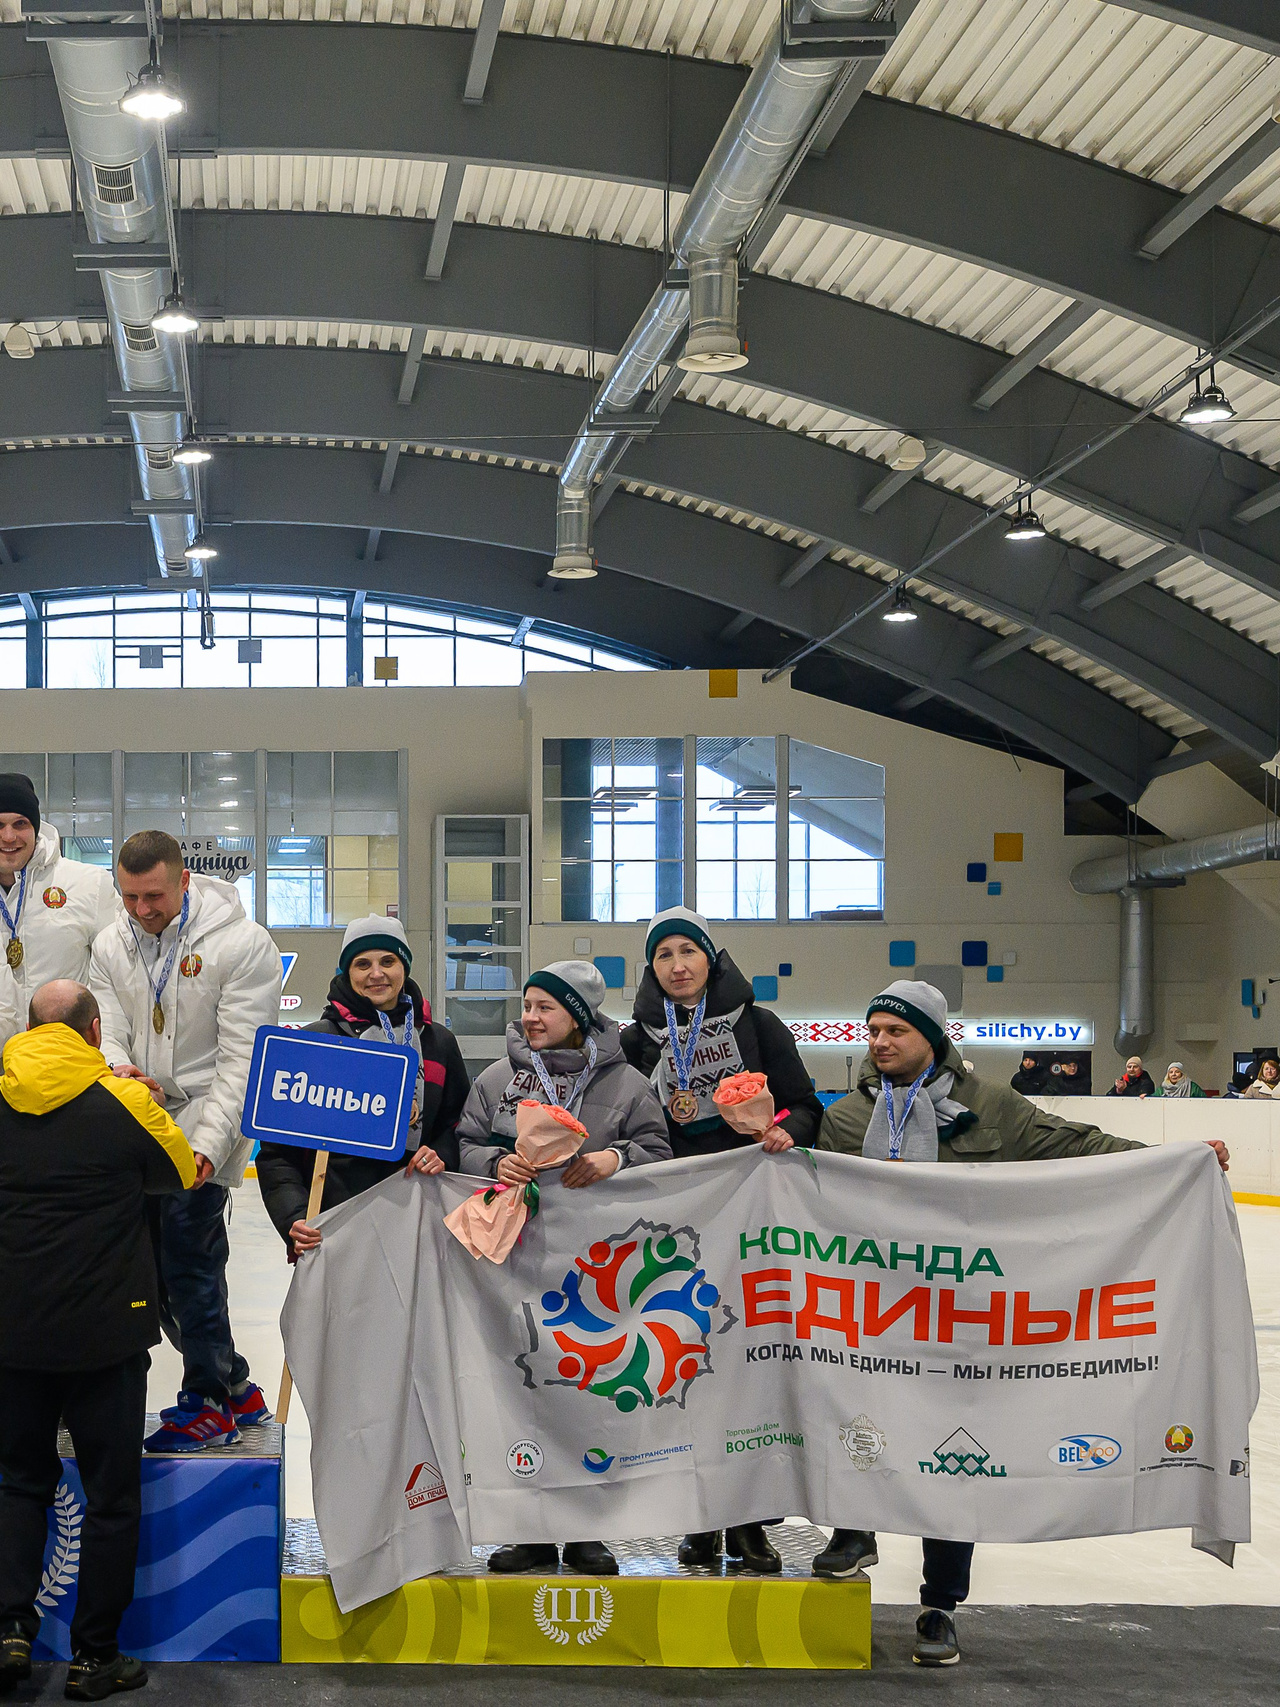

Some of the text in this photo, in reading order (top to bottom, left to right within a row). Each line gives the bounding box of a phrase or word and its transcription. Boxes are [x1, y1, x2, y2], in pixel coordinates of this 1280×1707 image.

[180, 841, 213, 851] АФЕ
[976, 1022, 1082, 1041] silichy.by
[668, 1041, 734, 1073] ЕИНЫЕ
[271, 1069, 387, 1117] Единые
[738, 1225, 1005, 1284] КОМАНДА
[741, 1267, 1158, 1349] ЕДИНЫЕ
[746, 1343, 804, 1363] КОГДА
[810, 1346, 845, 1366] МЫ
[849, 1353, 921, 1376] ЕДИНЫ
[953, 1363, 992, 1380] МЫ
[999, 1355, 1159, 1380] НЕПОБЕДИМЫ!
[619, 1444, 694, 1463] ПРОМТРАНСИНВЕСТ
[726, 1432, 805, 1454] ВОСТОЧНЫЙ
[547, 1588, 601, 1622] III
